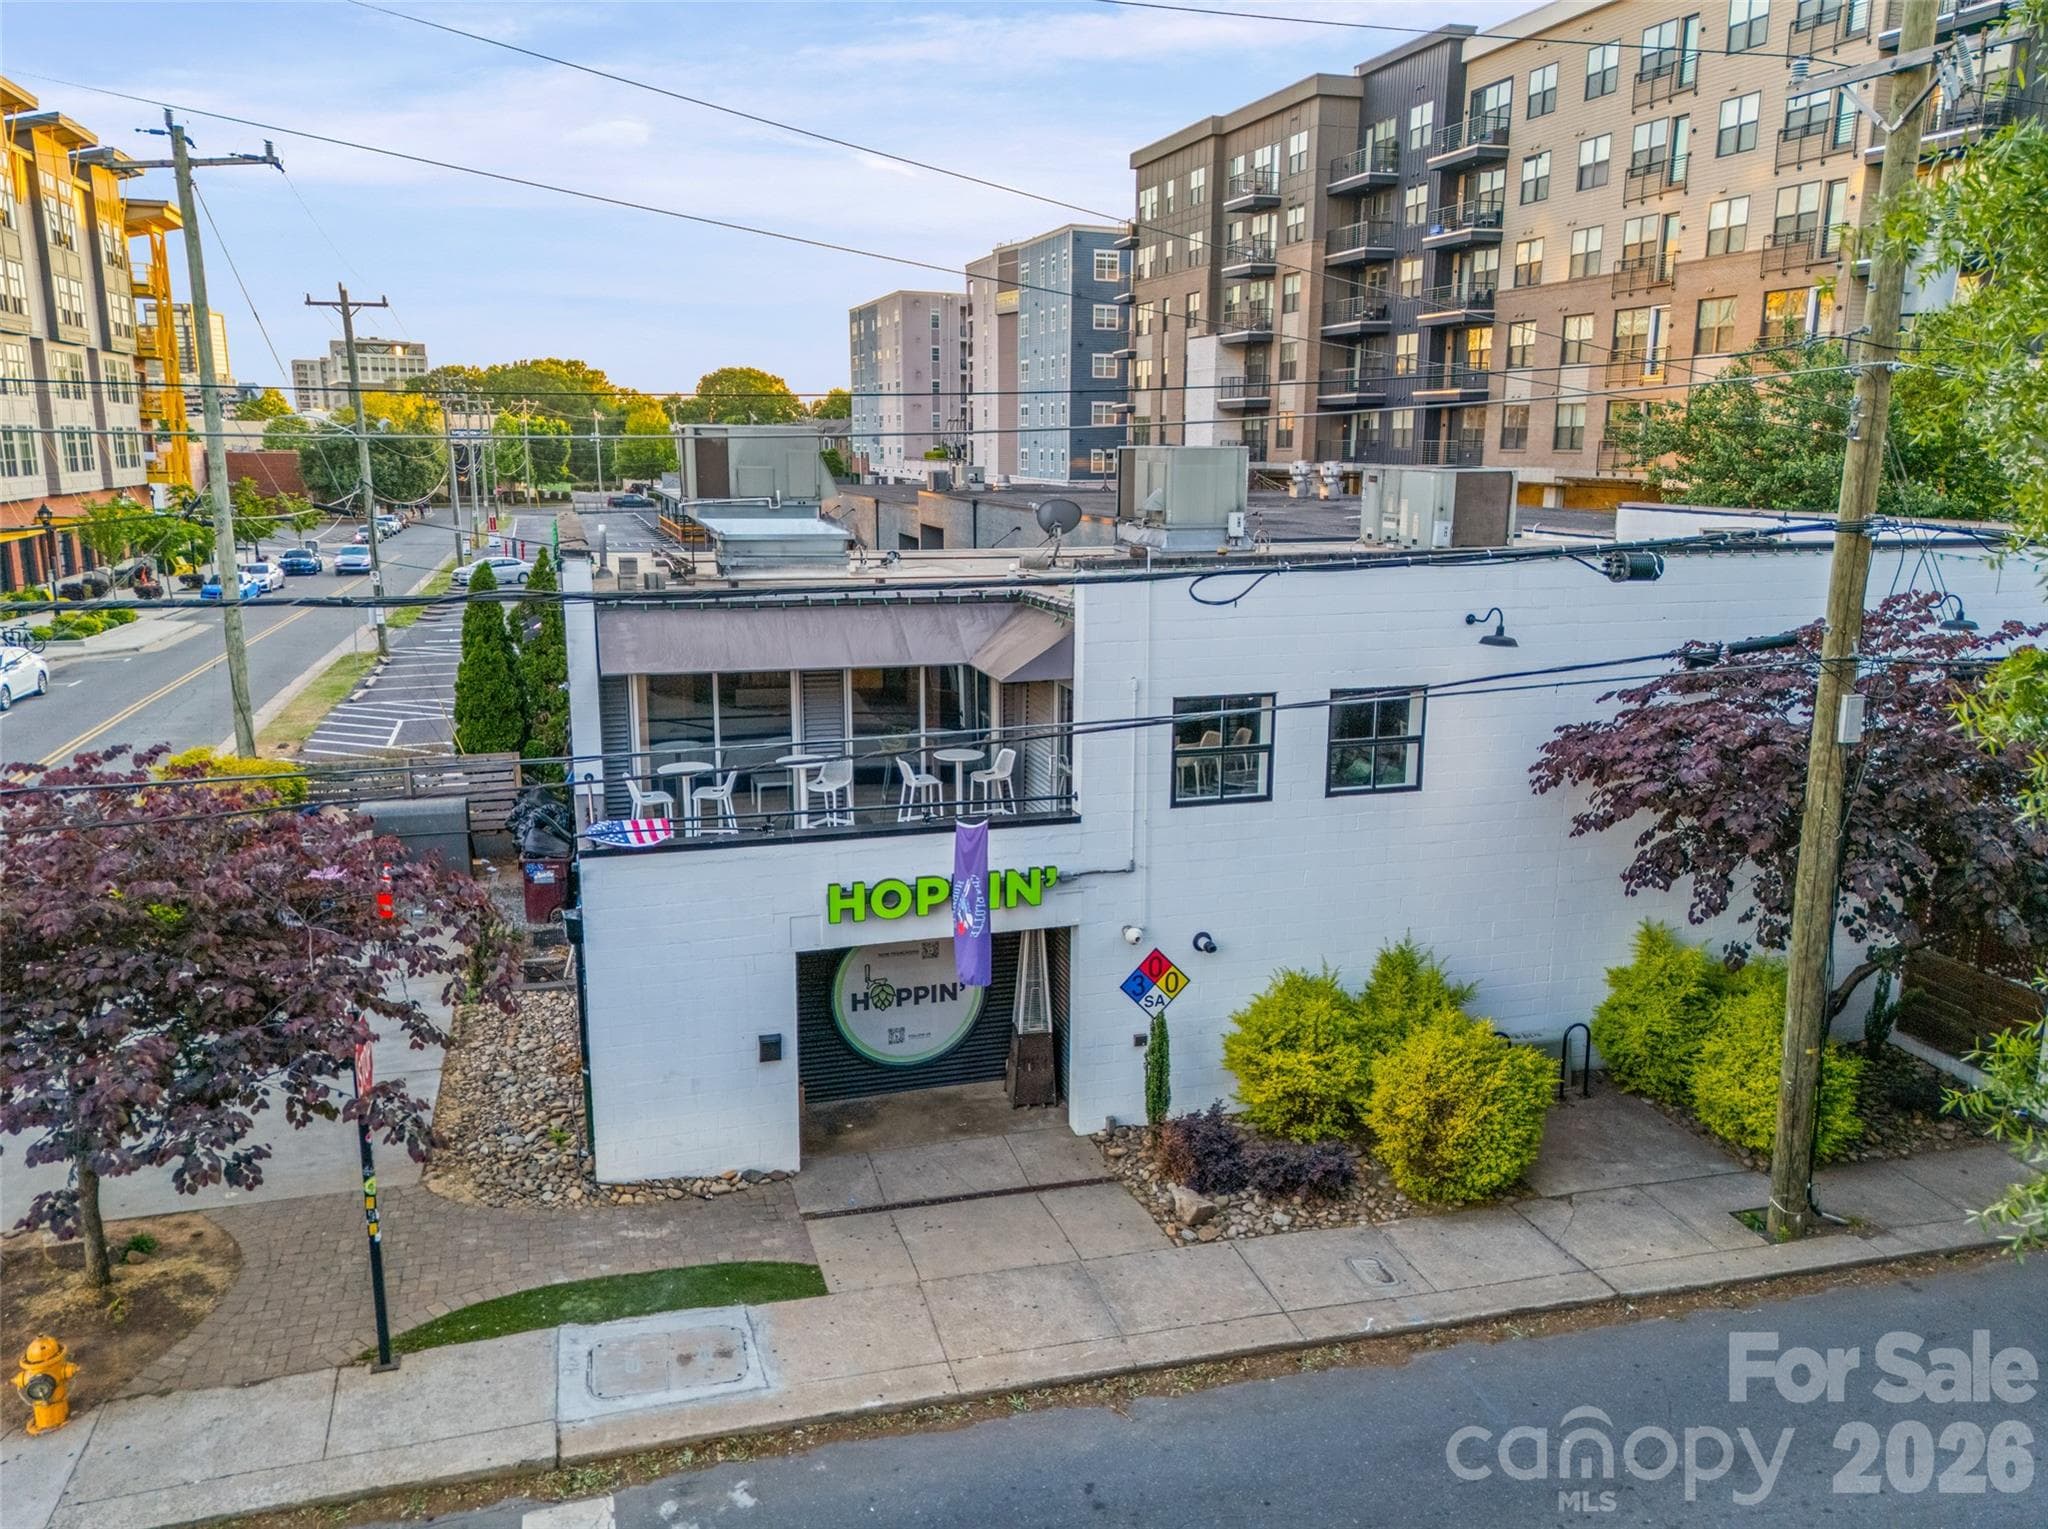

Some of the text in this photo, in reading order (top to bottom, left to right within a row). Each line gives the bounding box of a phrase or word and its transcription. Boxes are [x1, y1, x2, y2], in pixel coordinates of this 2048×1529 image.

[827, 865, 1058, 925] HOPIN'
[969, 873, 987, 939] CHARLOTTE
[1148, 956, 1163, 978] 0
[1131, 974, 1145, 997] 3
[1165, 971, 1179, 993] 0
[1144, 994, 1165, 1008] SA
